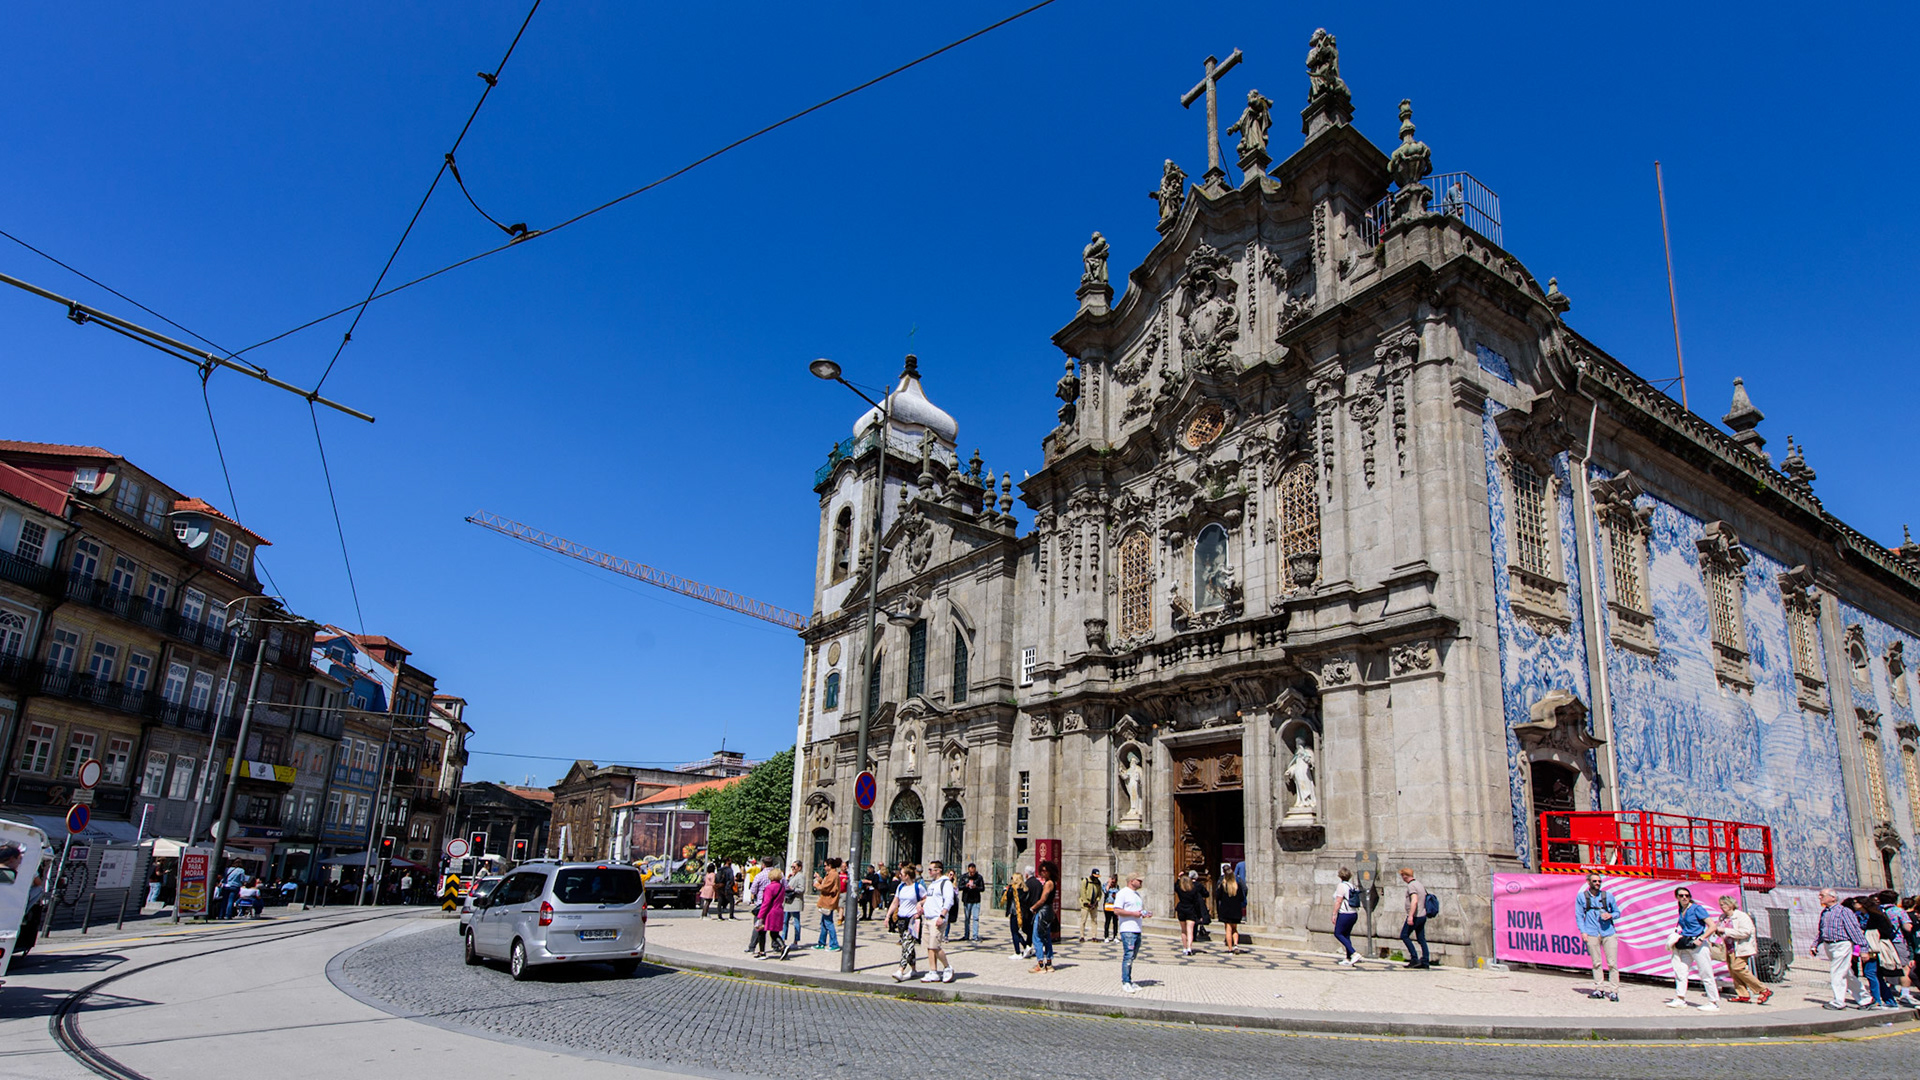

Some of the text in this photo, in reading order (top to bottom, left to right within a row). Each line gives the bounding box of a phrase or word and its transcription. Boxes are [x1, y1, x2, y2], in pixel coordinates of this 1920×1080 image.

[1507, 910, 1543, 930] NOVA
[1508, 931, 1591, 956] LINHA ROSA
